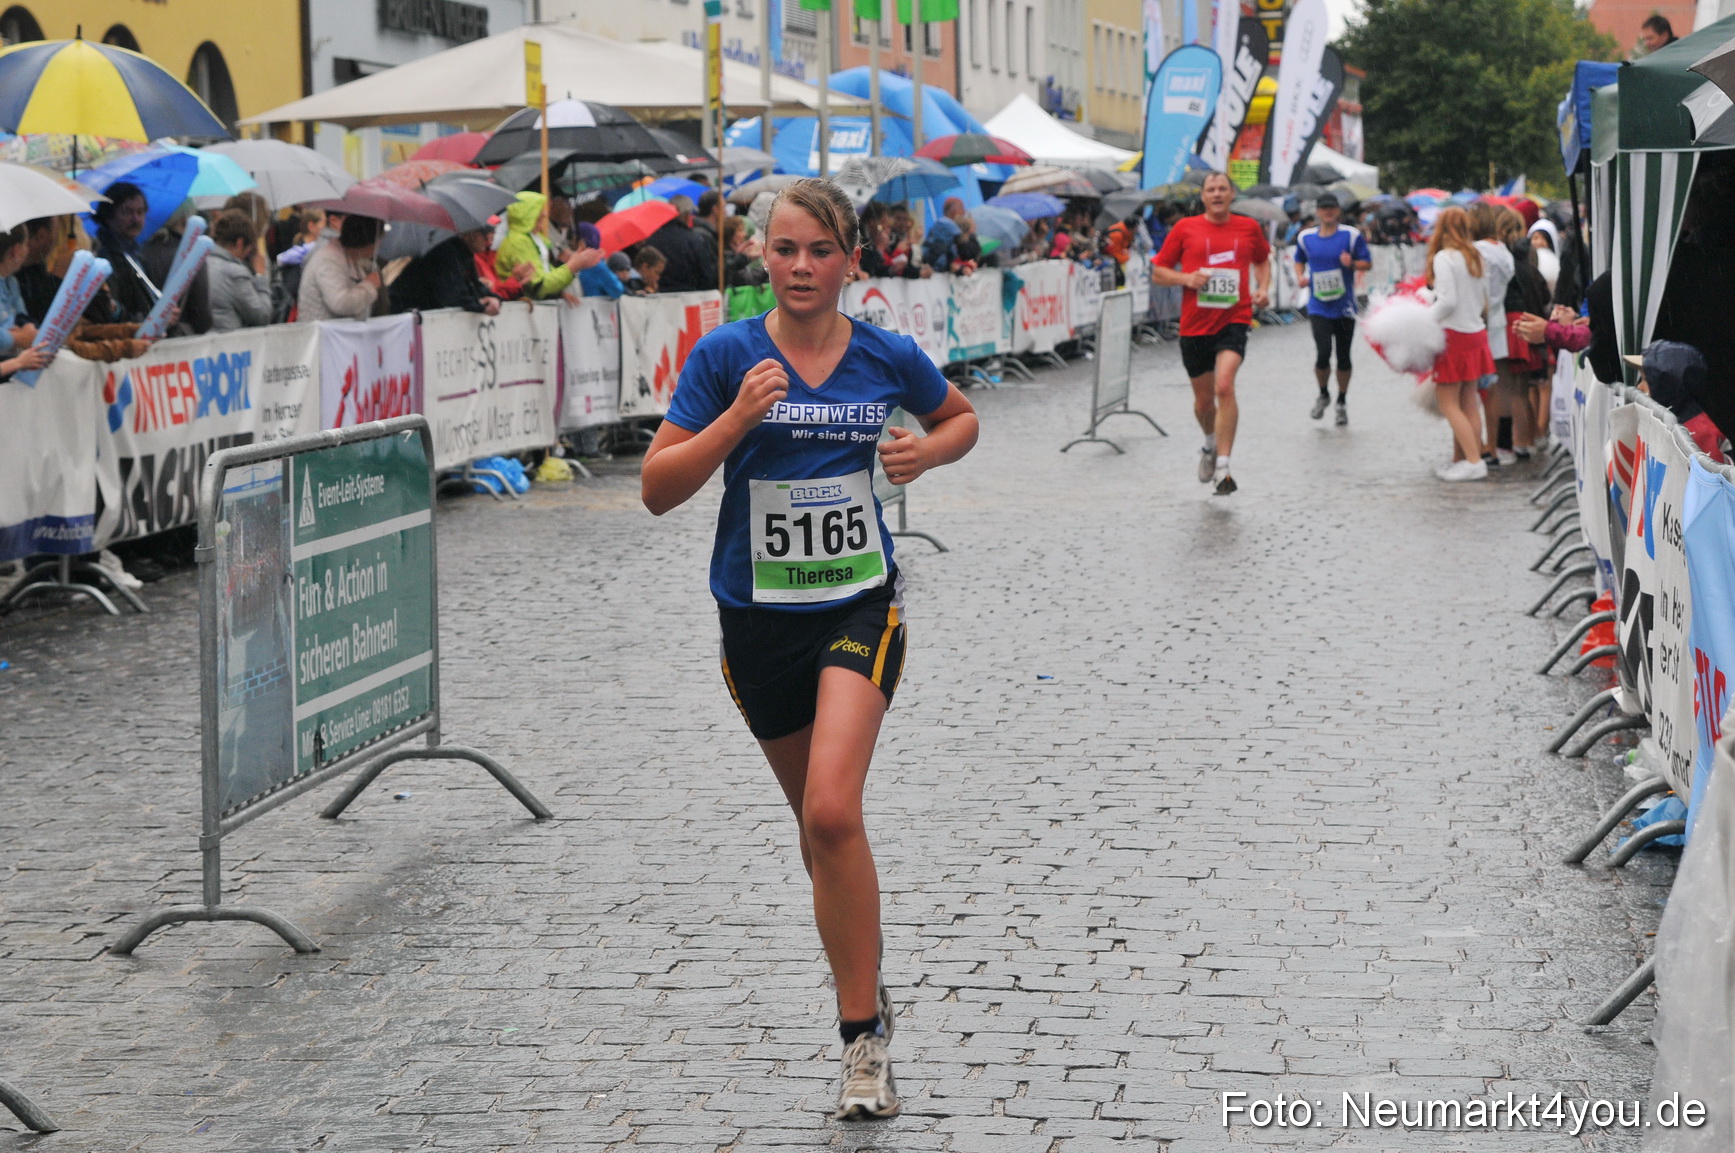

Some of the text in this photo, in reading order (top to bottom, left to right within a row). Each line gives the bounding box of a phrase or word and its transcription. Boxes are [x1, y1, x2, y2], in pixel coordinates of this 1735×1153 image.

[130, 350, 252, 434] INTERSPORT
[791, 430, 814, 439] Wir
[817, 430, 846, 441] sind
[317, 473, 385, 509] Event-Leit-Systeme
[790, 484, 842, 500] BOCK
[765, 505, 868, 557] 5165
[299, 552, 388, 620] Fun & Action in
[785, 566, 853, 585] Theresa
[300, 608, 398, 685] sicheren Bahnen!
[842, 640, 871, 658] asics
[329, 712, 354, 746] Service
[355, 705, 372, 734] Line:
